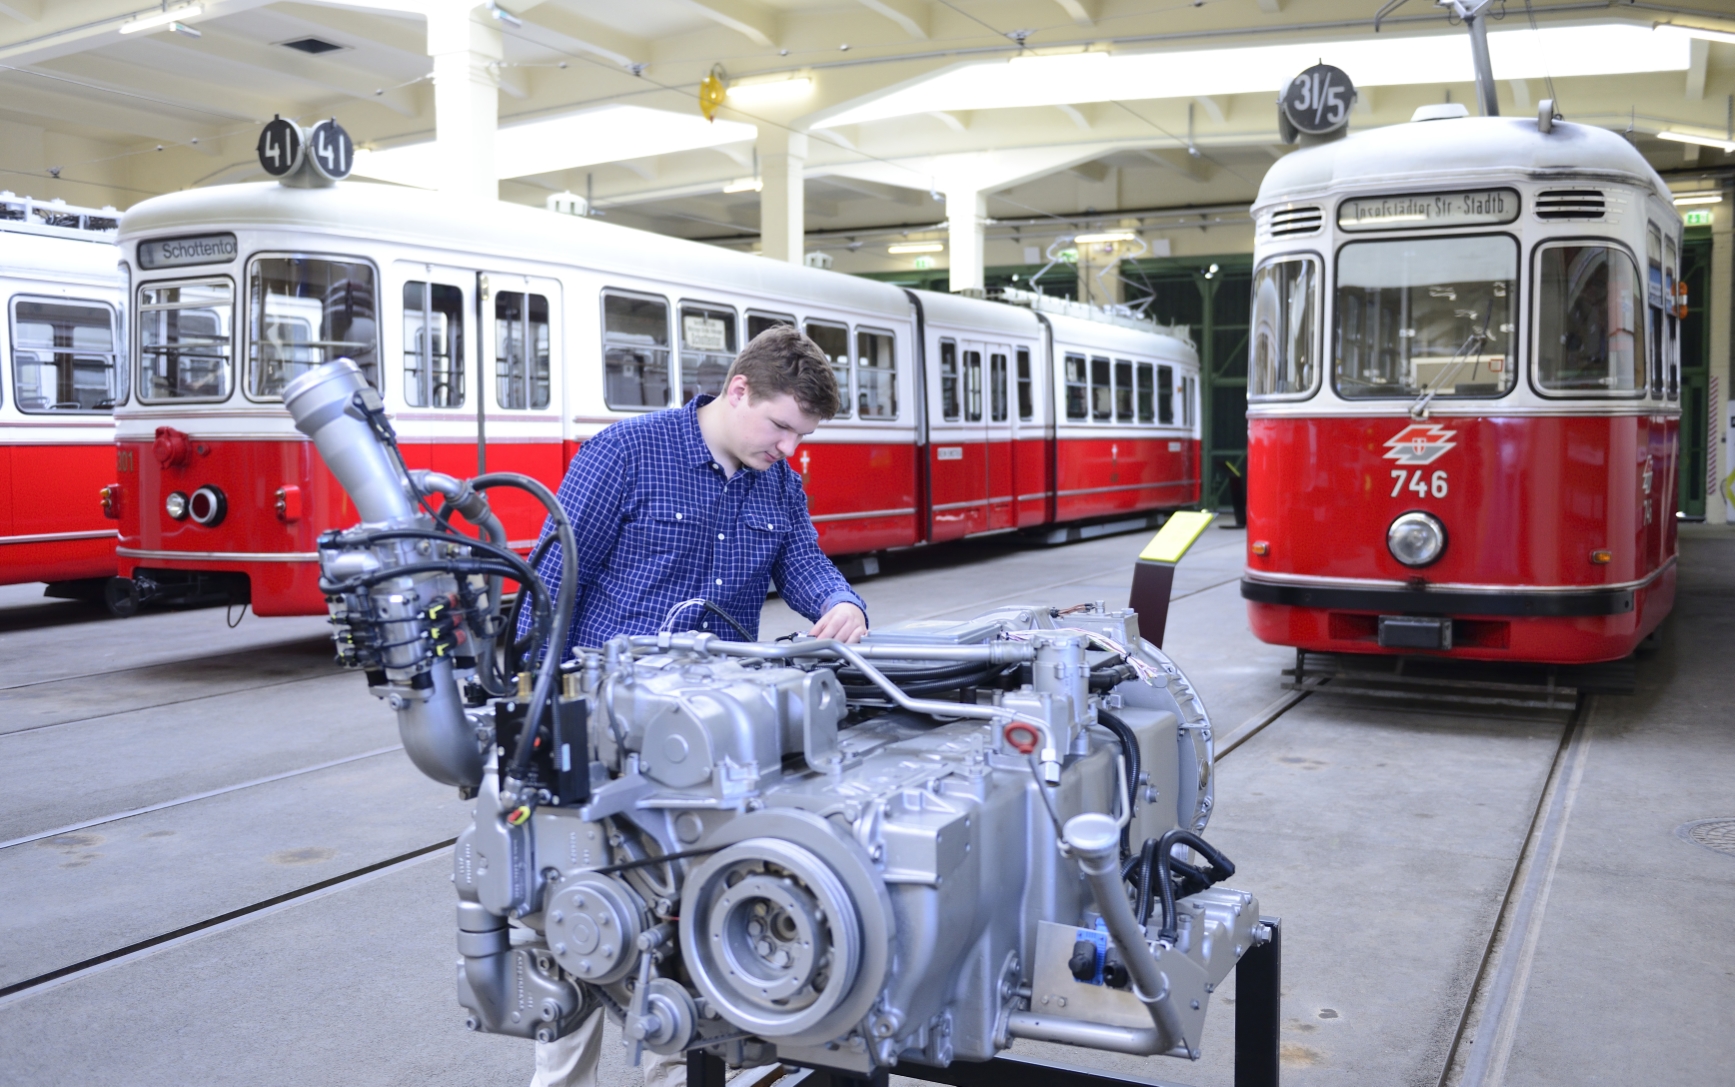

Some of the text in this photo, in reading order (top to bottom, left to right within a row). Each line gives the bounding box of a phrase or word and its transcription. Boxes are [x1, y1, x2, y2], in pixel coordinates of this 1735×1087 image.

[1293, 72, 1345, 125] 31/5
[265, 128, 292, 168] 41
[318, 130, 346, 173] 41
[1390, 469, 1448, 498] 746
